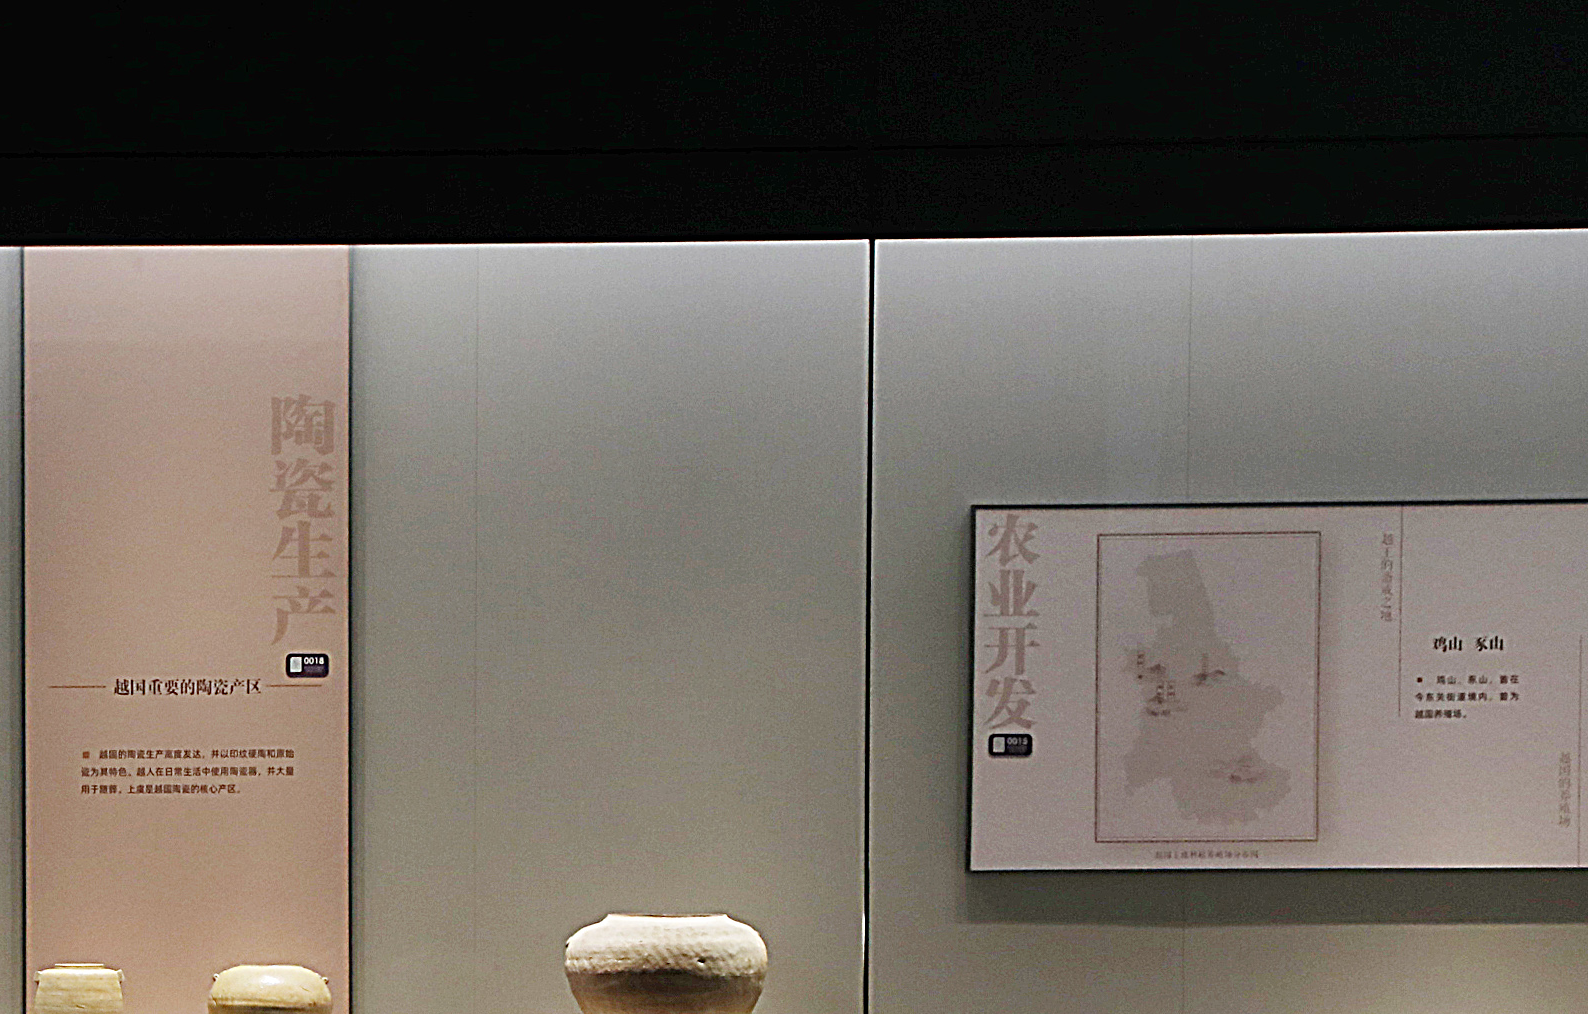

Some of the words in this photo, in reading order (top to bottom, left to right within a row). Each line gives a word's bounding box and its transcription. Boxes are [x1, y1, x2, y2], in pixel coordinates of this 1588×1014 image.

[270, 393, 336, 646] 陶瓷生产
[984, 512, 1041, 730] 农业开发
[1433, 635, 1463, 653] 鸡山
[303, 656, 325, 665] 0018
[113, 678, 262, 697] 越国重要的陶瓷产区
